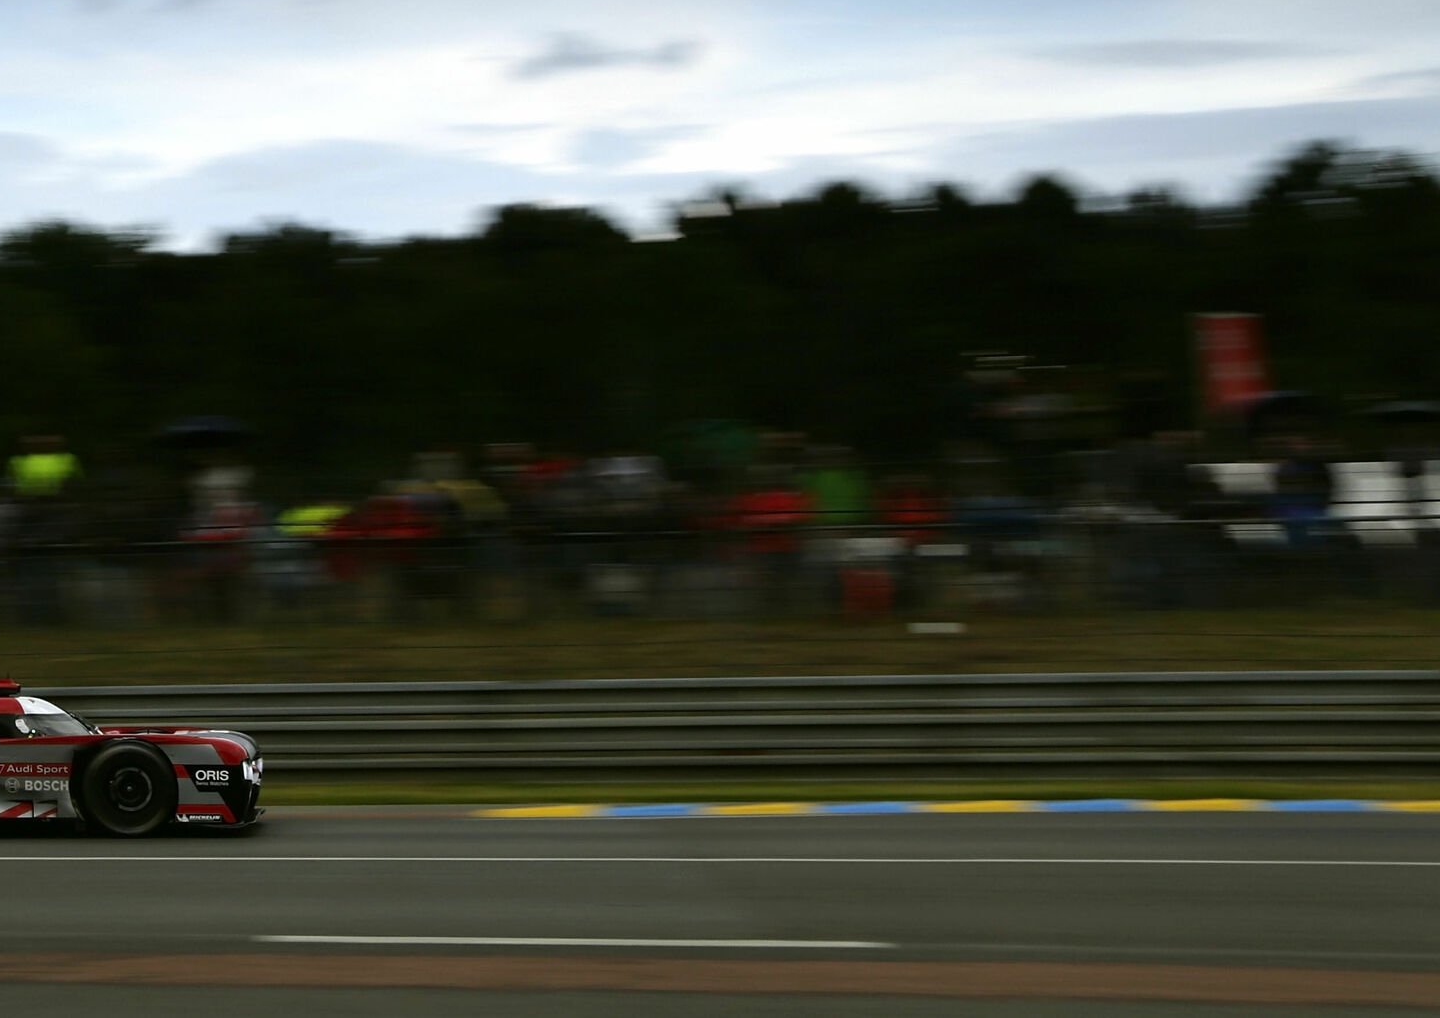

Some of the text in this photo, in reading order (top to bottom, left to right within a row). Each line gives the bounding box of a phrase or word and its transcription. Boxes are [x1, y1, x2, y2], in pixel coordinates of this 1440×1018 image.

[6, 764, 69, 775] Audi Sport
[195, 769, 230, 781] ORIS
[24, 780, 69, 791] BOSCH
